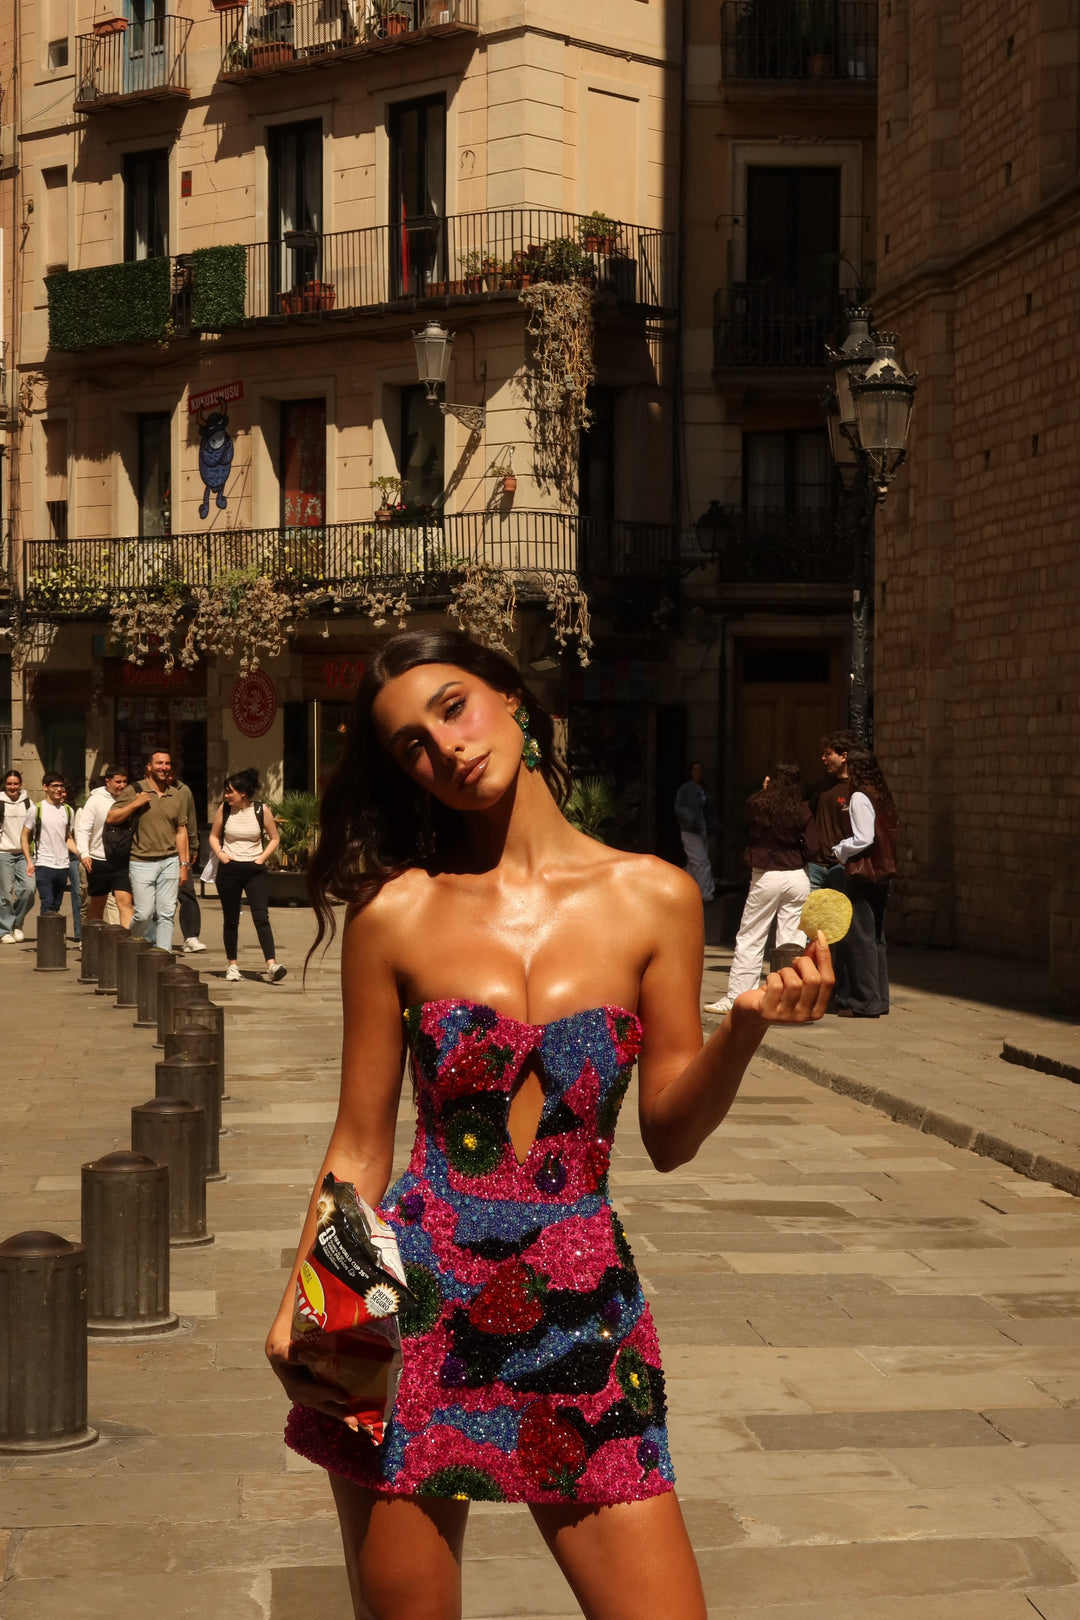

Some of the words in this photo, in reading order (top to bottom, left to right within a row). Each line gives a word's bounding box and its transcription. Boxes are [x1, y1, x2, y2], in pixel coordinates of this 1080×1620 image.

[333, 1235, 341, 1246] FIFA
[338, 1244, 353, 1263] WORLD
[351, 1261, 360, 1272] CUP
[371, 1294, 390, 1311] SEGURO
[375, 1289, 394, 1306] PREMIO
